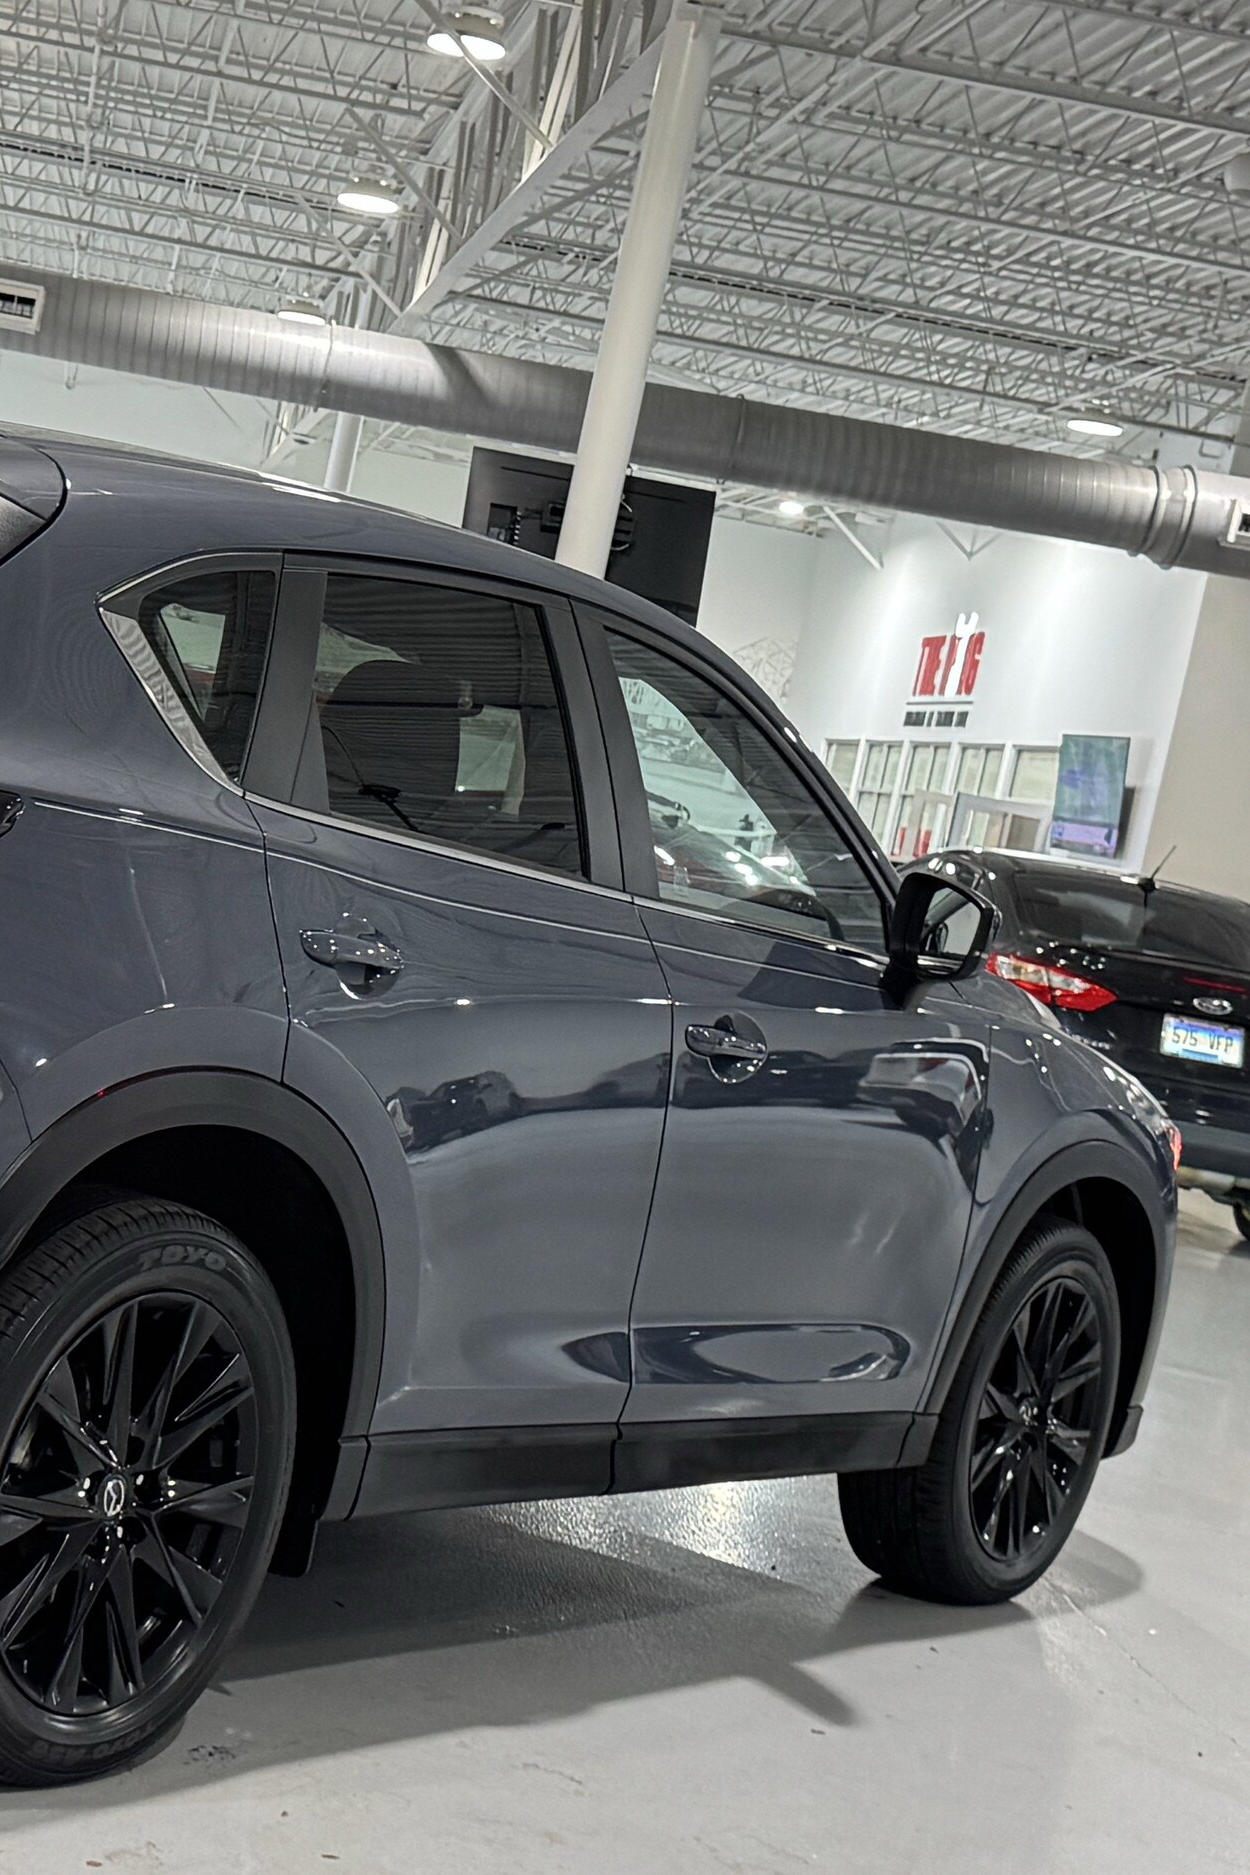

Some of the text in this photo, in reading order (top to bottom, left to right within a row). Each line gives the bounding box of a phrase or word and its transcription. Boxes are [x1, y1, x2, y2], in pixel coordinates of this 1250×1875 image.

[1172, 1025, 1234, 1053] 575 VFP
[139, 1244, 226, 1272] TOYO
